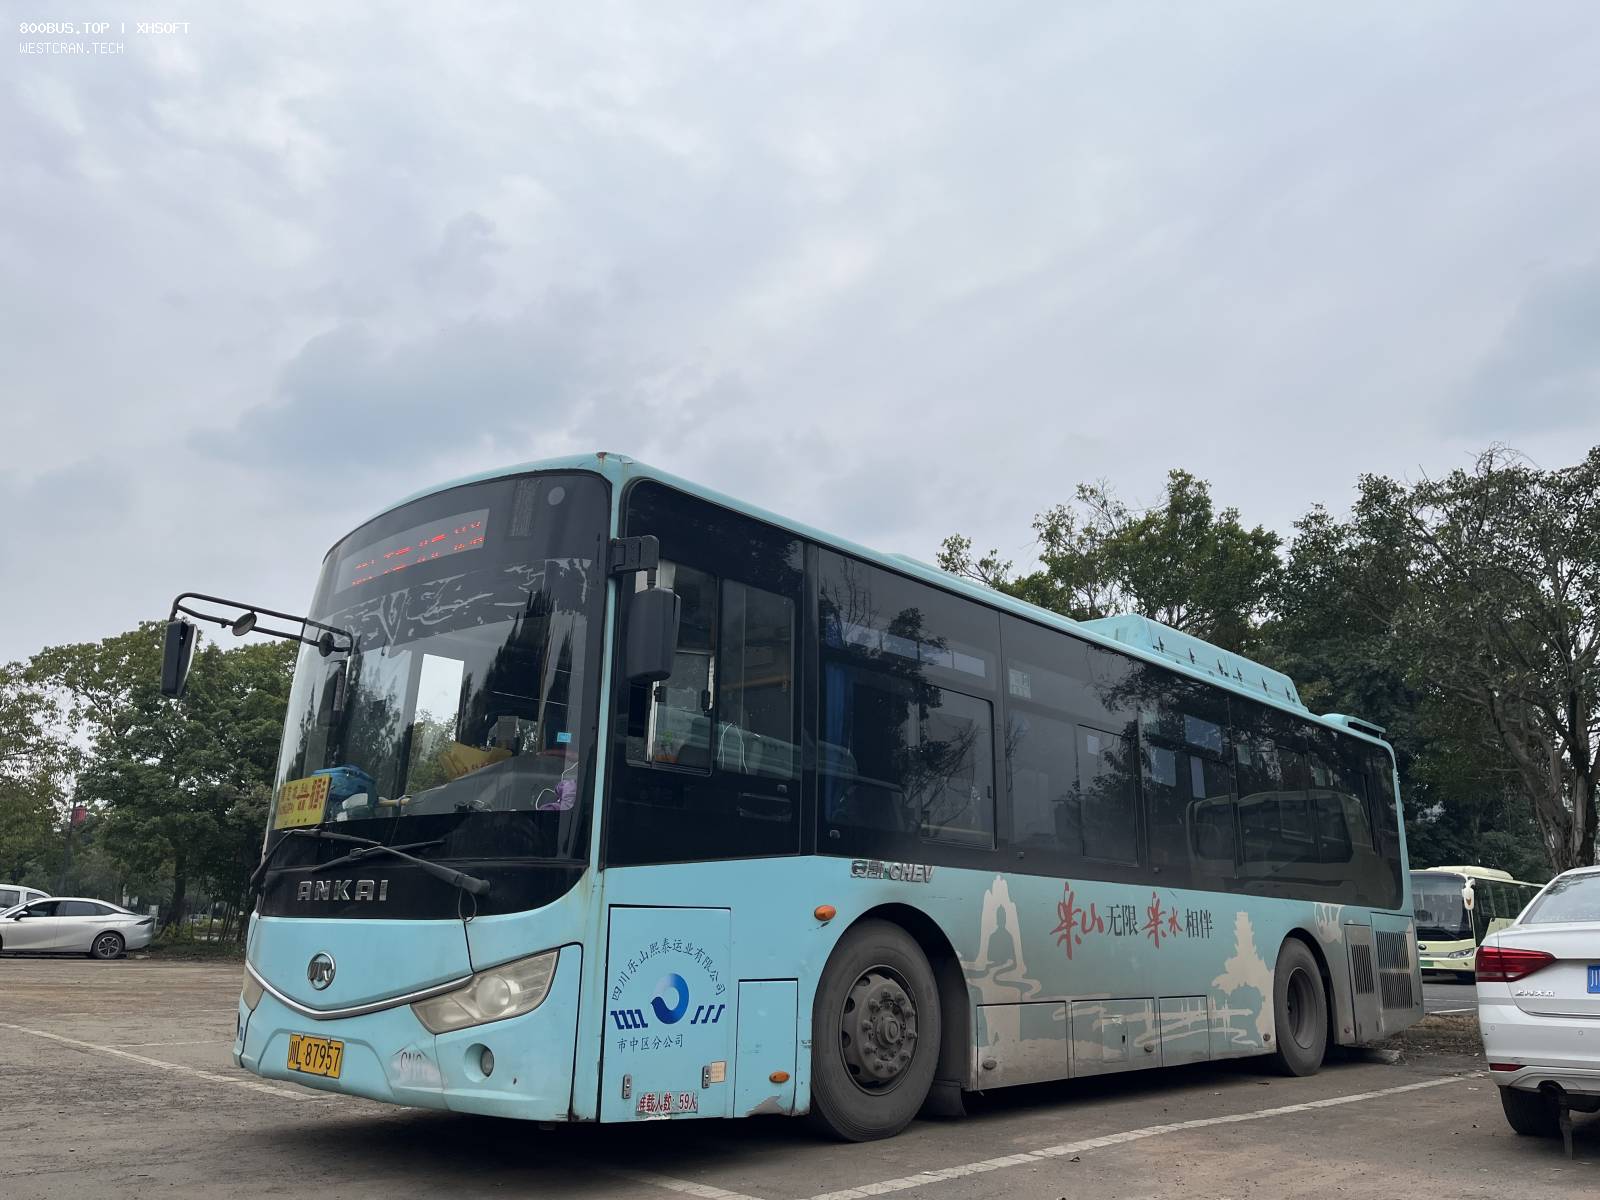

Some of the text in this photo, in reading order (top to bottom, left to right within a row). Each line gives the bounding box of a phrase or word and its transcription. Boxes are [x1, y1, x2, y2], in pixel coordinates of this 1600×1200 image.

[297, 879, 389, 901] ANKAI
[617, 1033, 683, 1054] 市中区分公司
